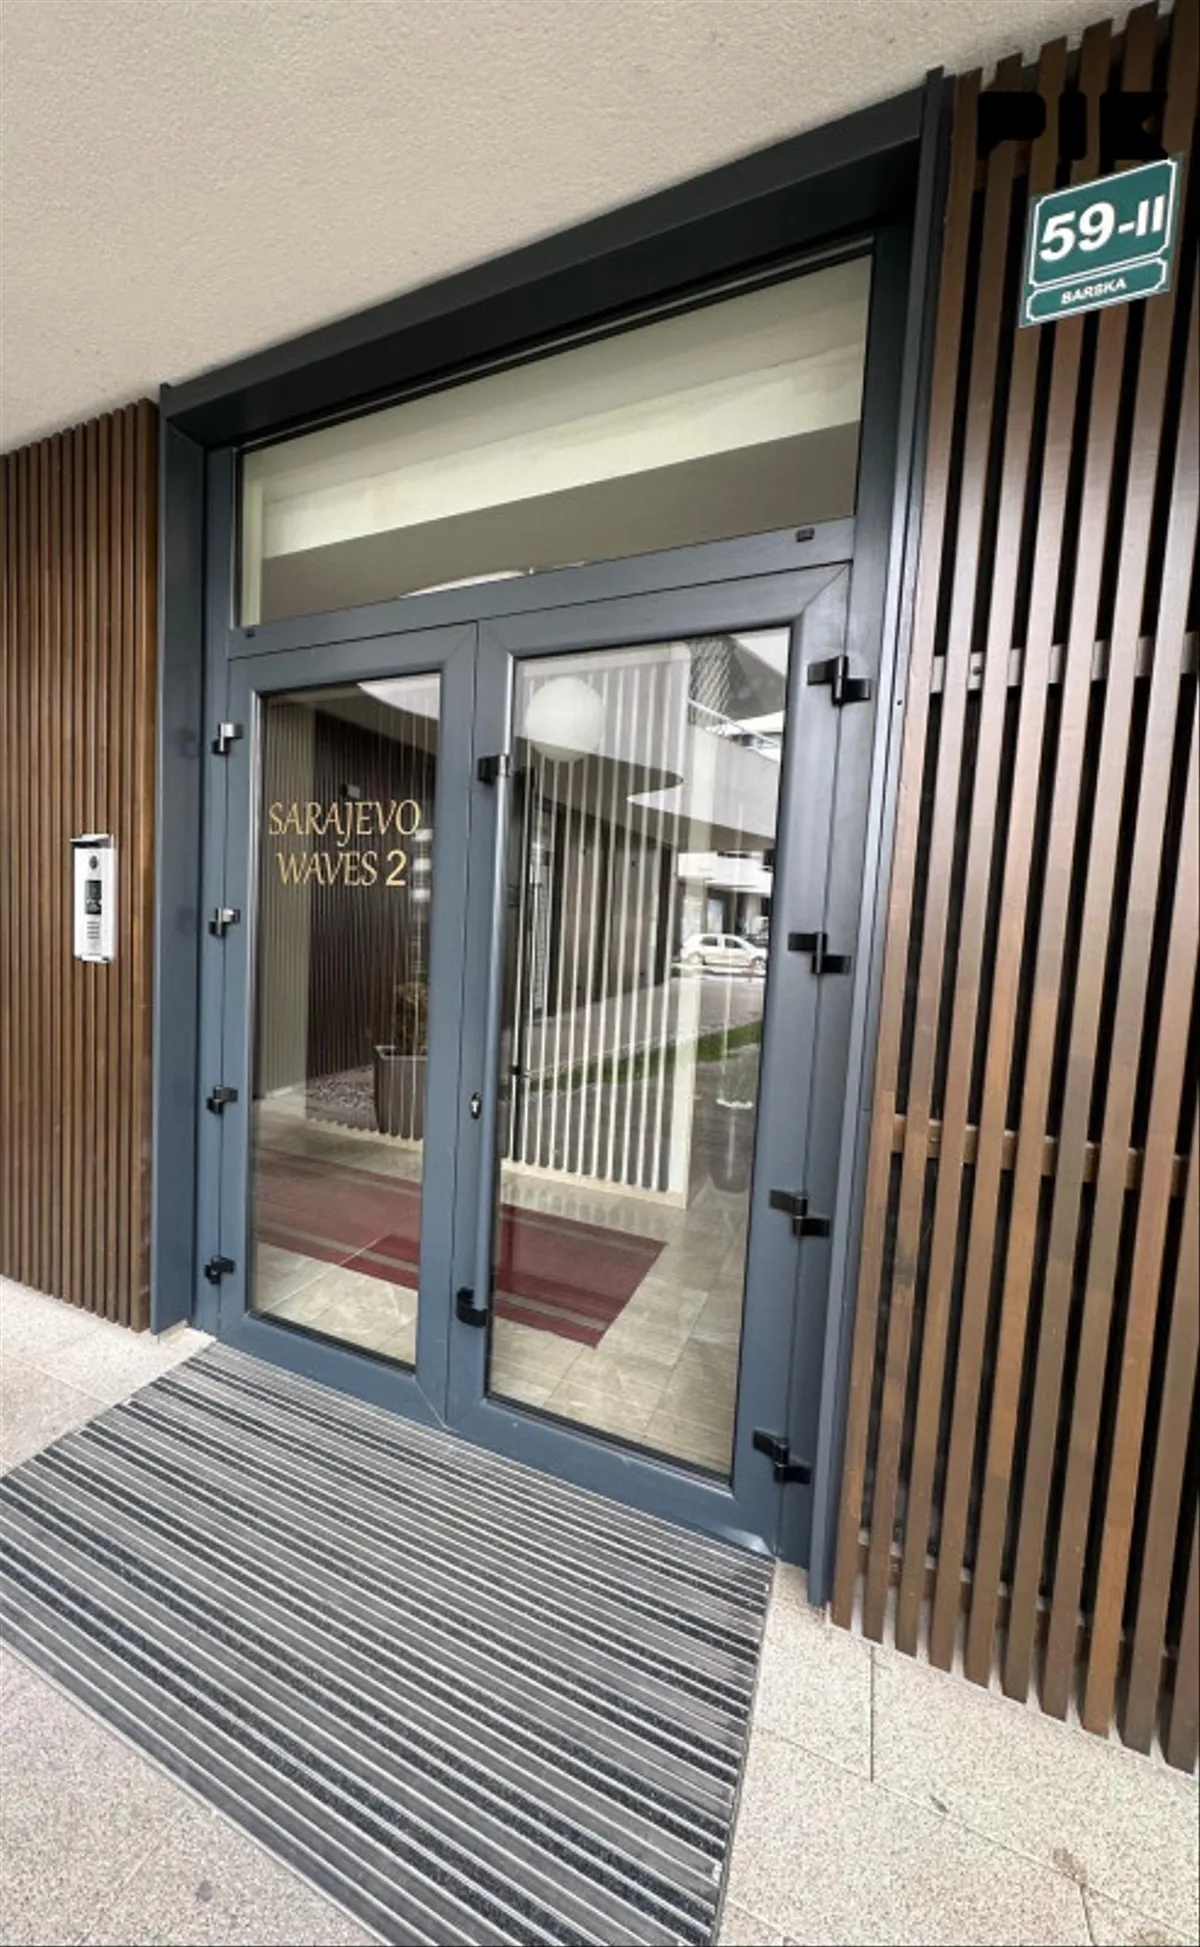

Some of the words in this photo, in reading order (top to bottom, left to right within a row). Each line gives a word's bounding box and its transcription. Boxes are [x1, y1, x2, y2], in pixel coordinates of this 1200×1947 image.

[1039, 195, 1165, 262] 59-II
[1061, 278, 1127, 305] BARSKA
[268, 799, 421, 847] SARAJEVO
[276, 851, 378, 886] WAVES
[386, 850, 407, 886] 2
